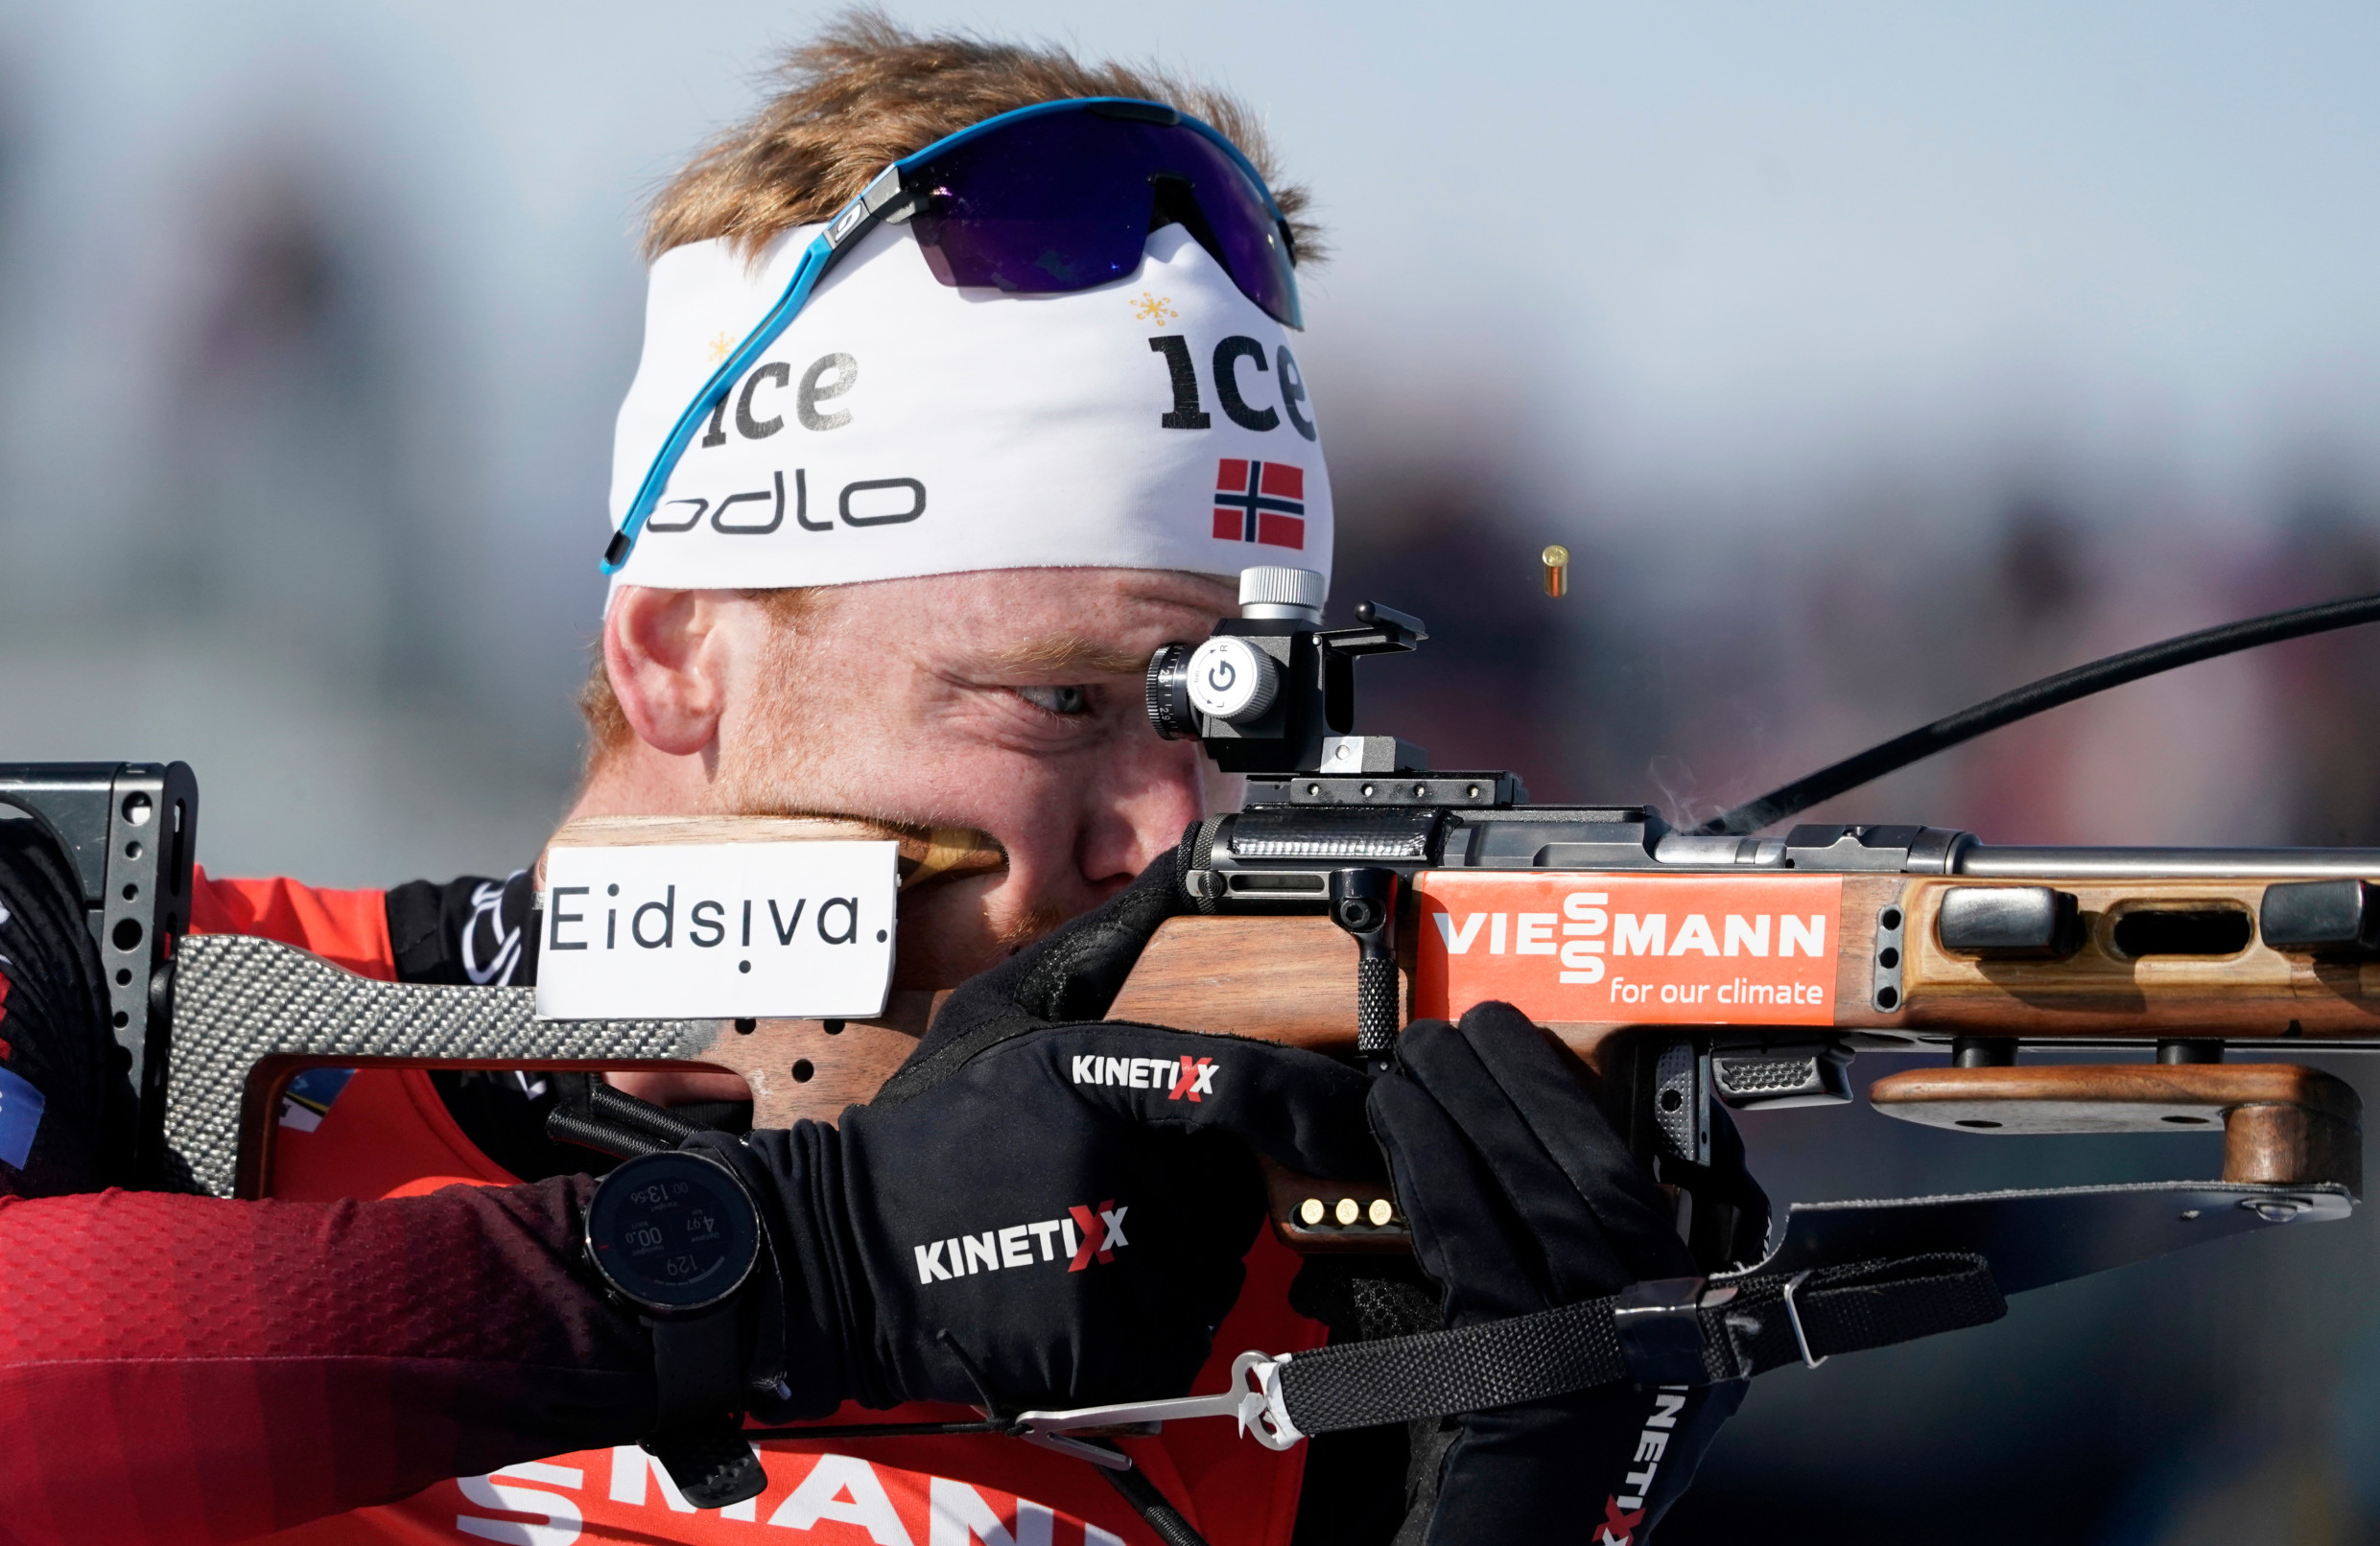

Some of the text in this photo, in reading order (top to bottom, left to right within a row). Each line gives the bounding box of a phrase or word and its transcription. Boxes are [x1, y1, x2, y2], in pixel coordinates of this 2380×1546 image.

[646, 468, 926, 535] odlo
[550, 884, 888, 974] Eidsiva.
[1432, 892, 1826, 984] VIESSMANN
[1610, 976, 1824, 1005] for our climate
[1072, 1054, 1220, 1102] KINETIXX
[666, 1254, 698, 1276] 129
[914, 1198, 1129, 1285] KINETIXX
